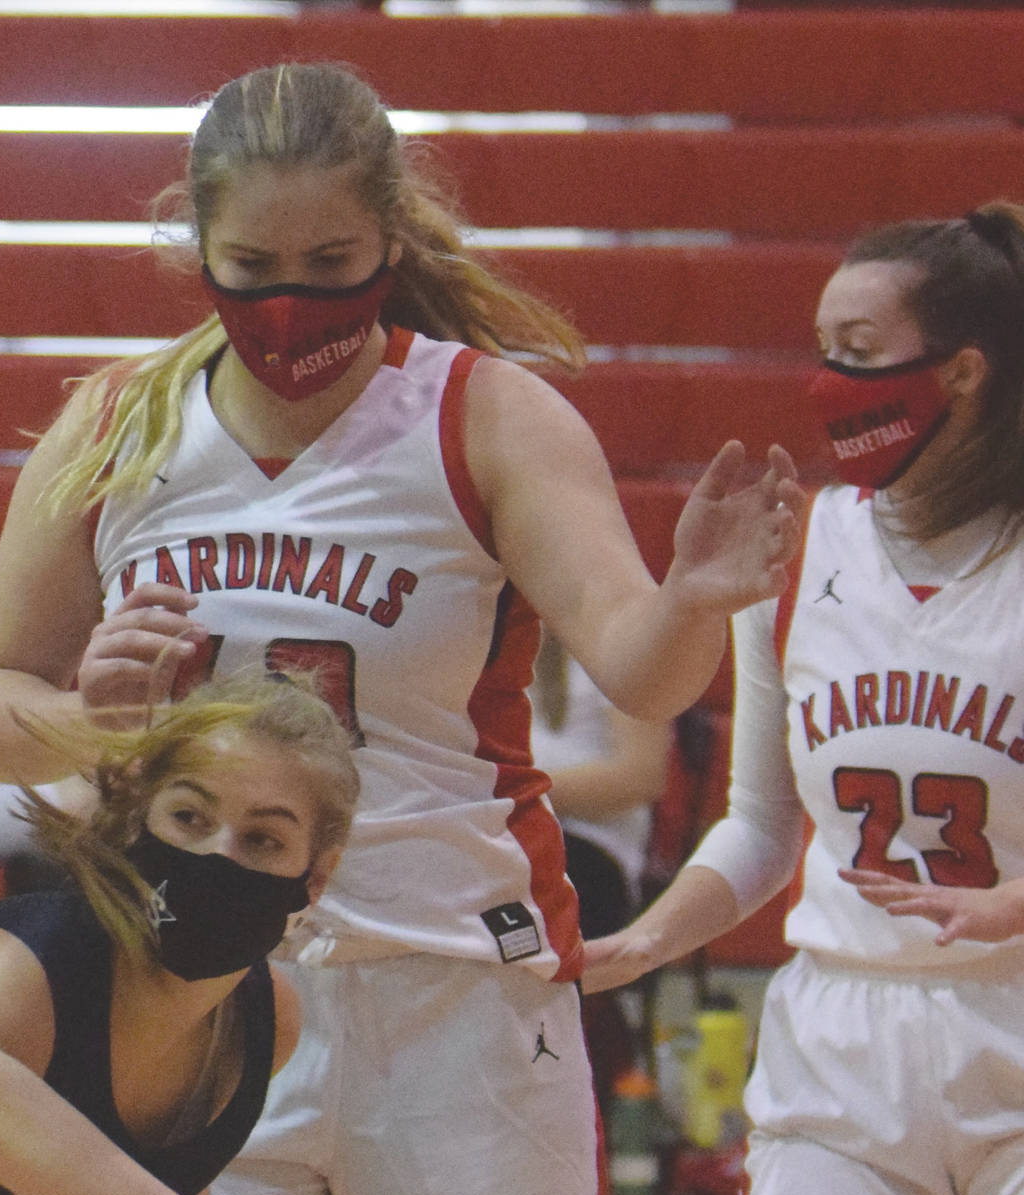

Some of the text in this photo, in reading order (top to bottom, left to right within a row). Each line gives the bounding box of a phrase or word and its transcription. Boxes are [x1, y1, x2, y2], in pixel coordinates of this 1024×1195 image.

[291, 326, 367, 382] BASKETBALL
[833, 418, 916, 460] BASKETBALL
[833, 766, 1000, 889] 23
[500, 912, 519, 926] L
